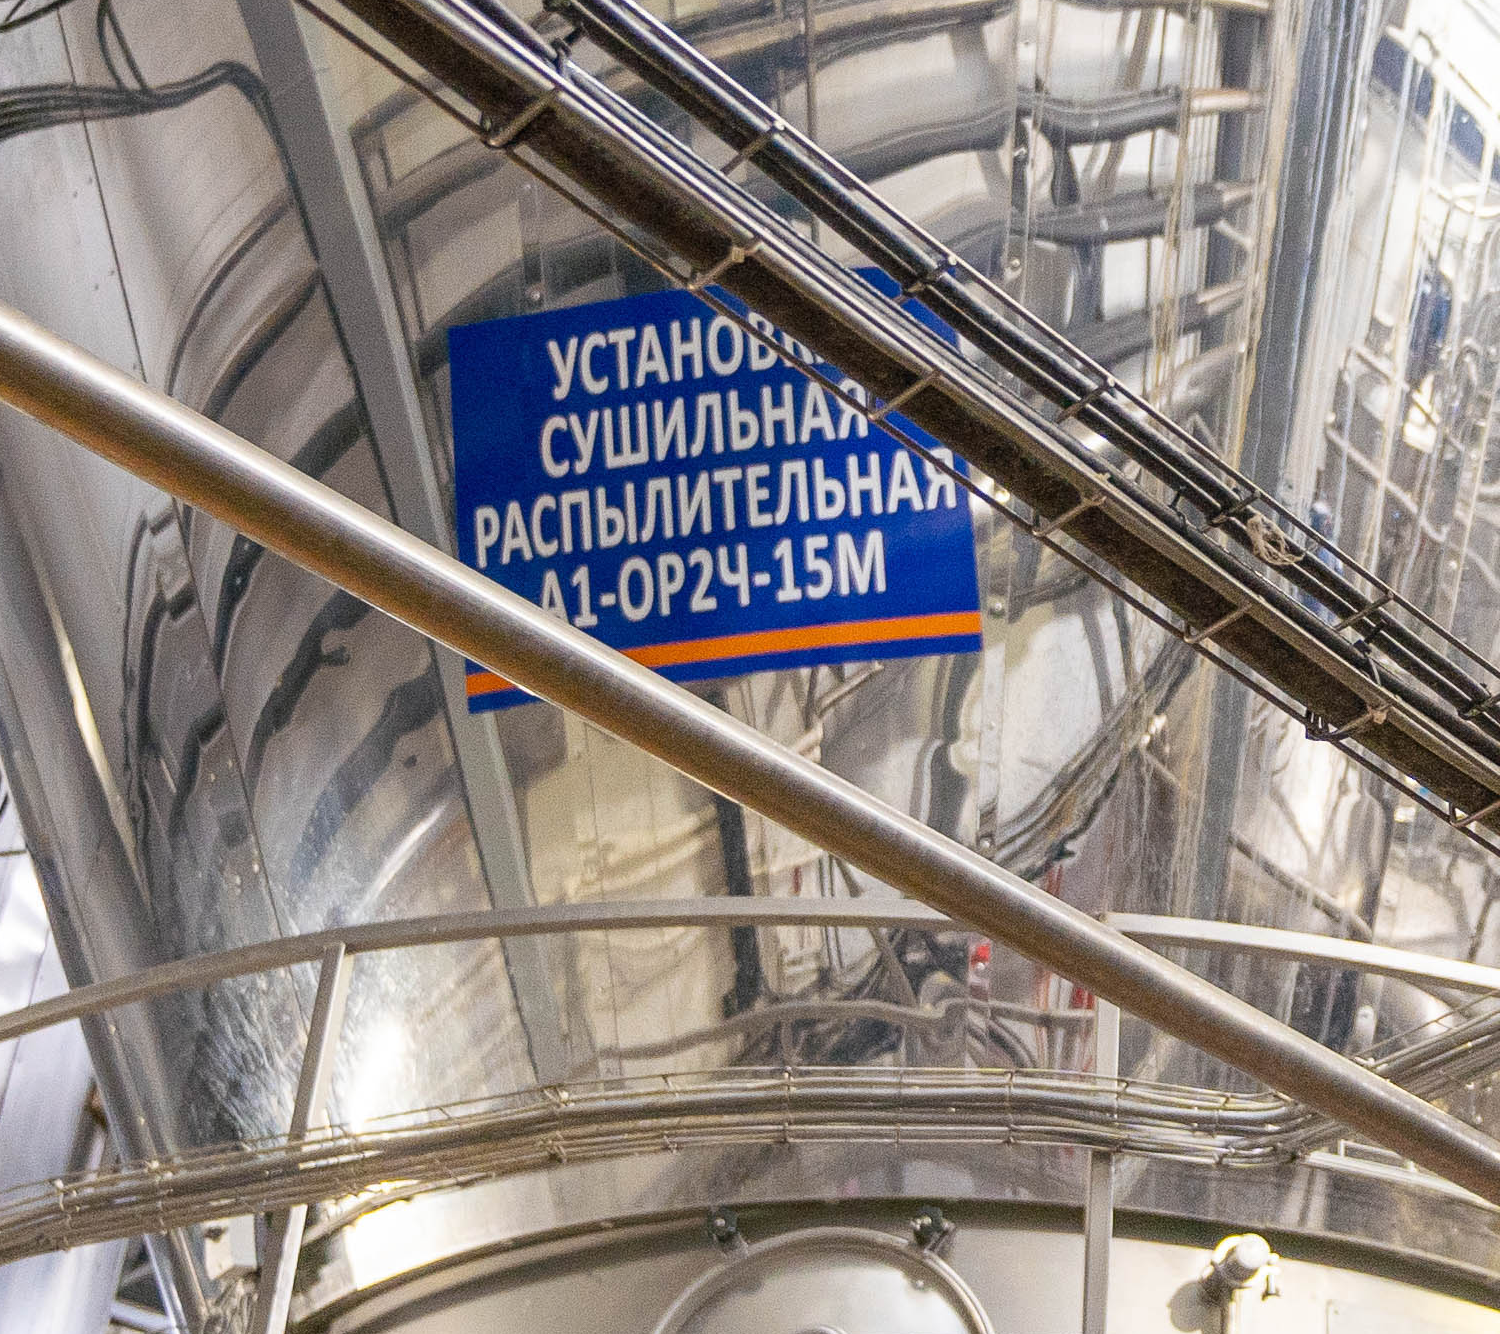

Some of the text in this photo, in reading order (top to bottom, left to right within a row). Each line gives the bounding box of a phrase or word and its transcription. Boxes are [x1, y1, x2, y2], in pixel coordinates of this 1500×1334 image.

[547, 311, 825, 400] УСТАНОВК
[539, 379, 870, 478] СУШИЛЬНАЯ
[474, 447, 958, 569] РАСПЫЛИТЕЛЬНАЯ
[540, 530, 886, 630] А1-ОР2Ч-15М
